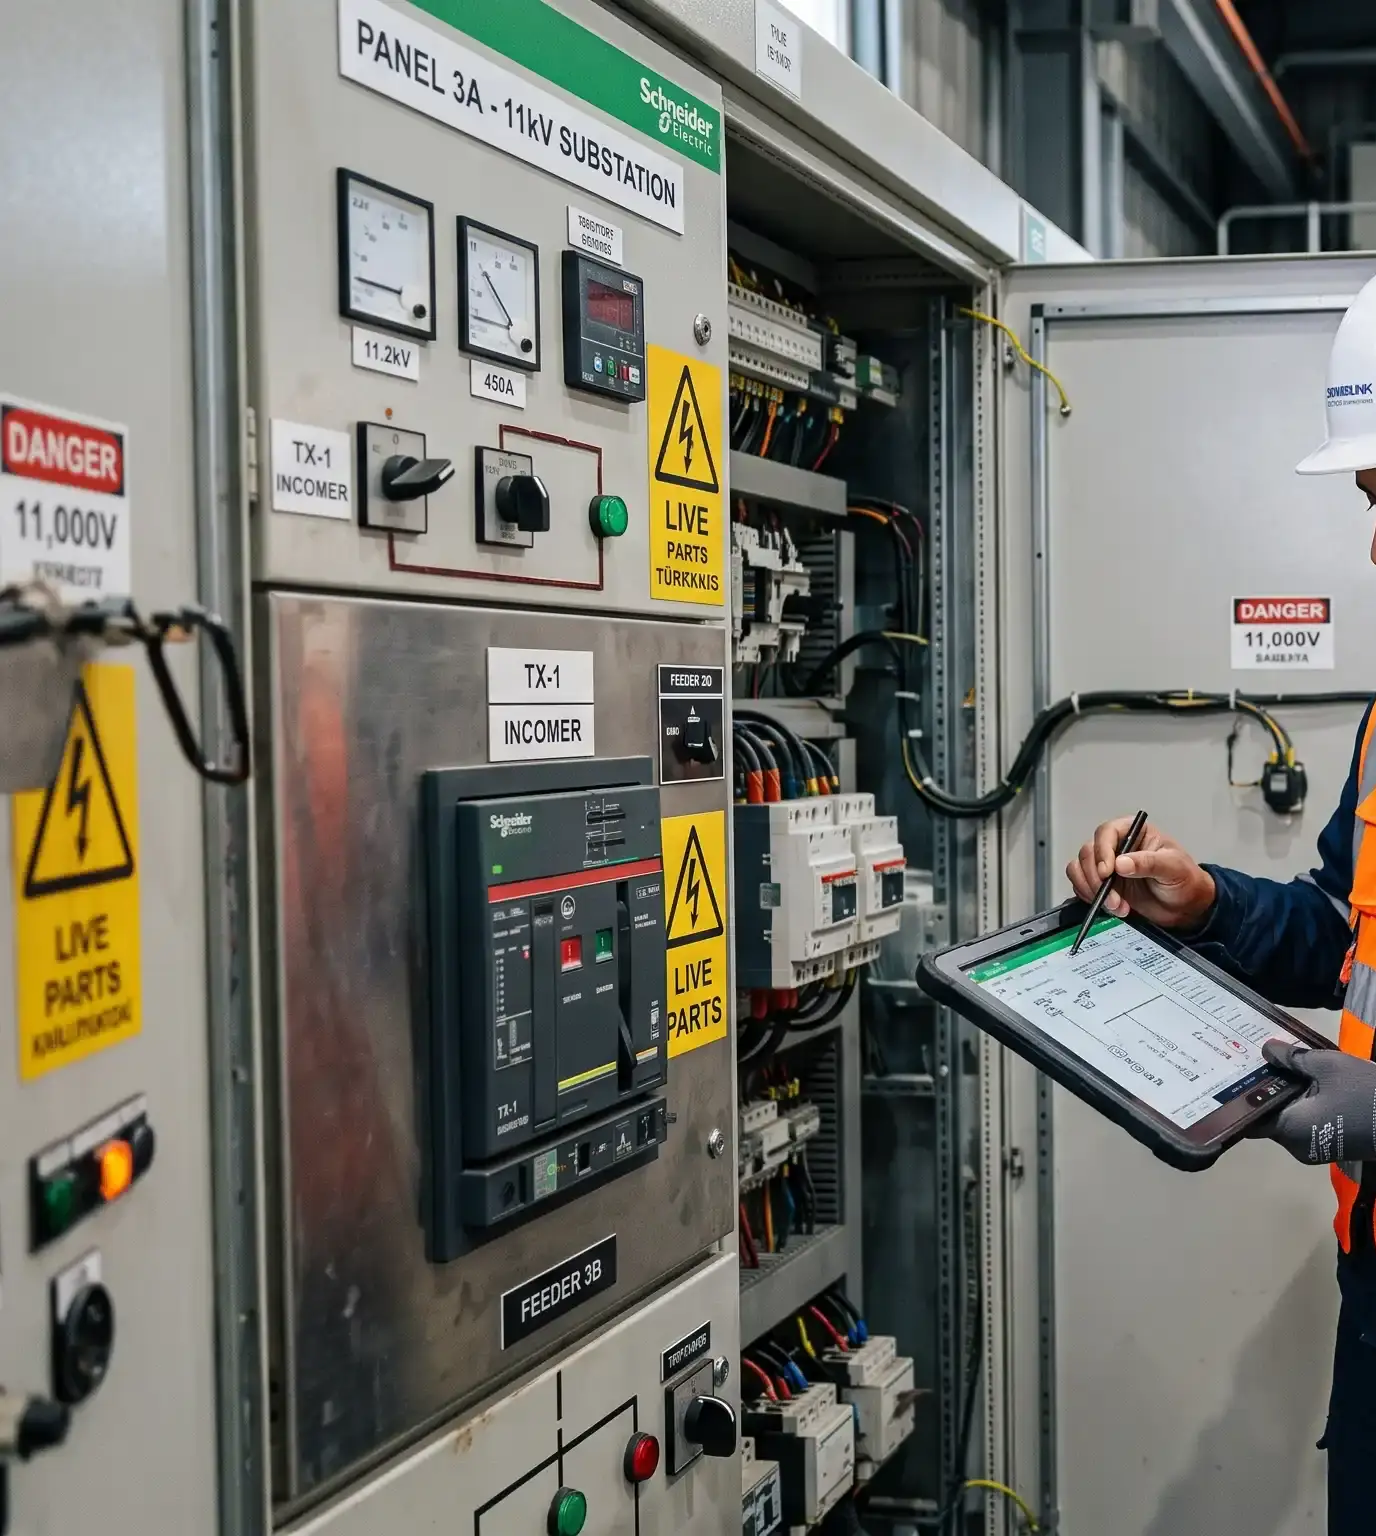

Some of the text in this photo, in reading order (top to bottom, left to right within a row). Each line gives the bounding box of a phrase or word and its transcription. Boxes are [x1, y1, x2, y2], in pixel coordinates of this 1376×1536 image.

[357, 18, 446, 95] PANEL
[452, 70, 484, 115] 3A
[503, 98, 554, 147] 11kV
[559, 125, 676, 209] SUBSTATION
[639, 77, 714, 138] Schneider
[672, 126, 713, 157] Electric
[364, 340, 411, 368] 11.2kV
[484, 373, 515, 396] 450A
[8, 420, 118, 482] DANGER
[292, 441, 332, 468] TX-1
[276, 473, 349, 502] INCOMER
[15, 499, 117, 550] 11,000V
[665, 499, 709, 537] LIVE
[667, 541, 709, 564] PARTS
[1240, 603, 1325, 619] DANGER
[1244, 631, 1320, 650] 11,000V
[524, 663, 560, 689] TX-1
[670, 673, 700, 687] FEEDER
[504, 719, 582, 745] INCOMER
[55, 913, 110, 963] LIVE
[44, 959, 121, 1018] PARTS
[675, 957, 713, 996] LIVE
[667, 995, 722, 1041] PARTS
[521, 1259, 602, 1323] FEEDER 3B
